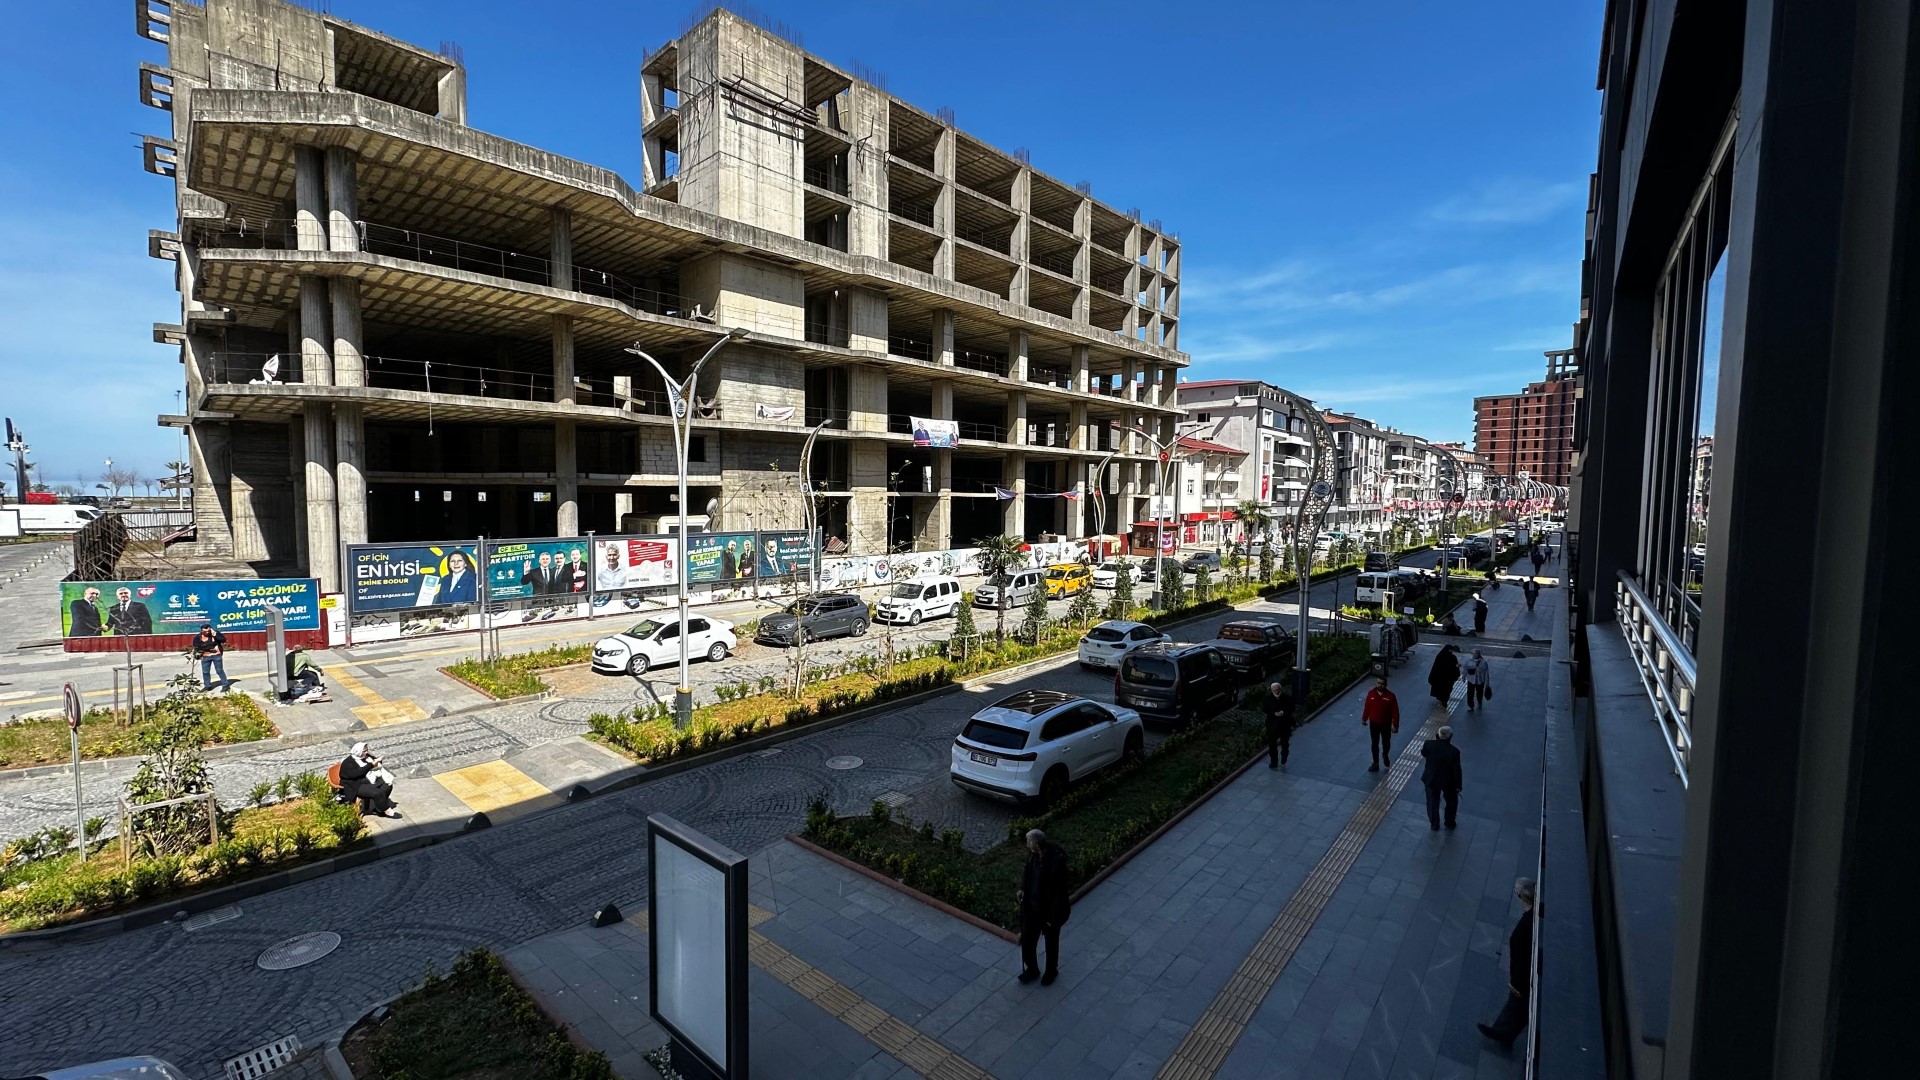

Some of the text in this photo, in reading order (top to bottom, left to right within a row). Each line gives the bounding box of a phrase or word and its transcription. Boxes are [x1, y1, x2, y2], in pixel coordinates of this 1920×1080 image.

[358, 552, 389, 562] OF İÇİN
[357, 559, 420, 578] EN İYİSİ
[382, 577, 409, 585] BODUR
[249, 583, 307, 597] SÖZÜMÜZ
[235, 595, 292, 609] YAPACAK
[219, 611, 244, 623] ÇOK
[281, 605, 307, 615] VAR!
